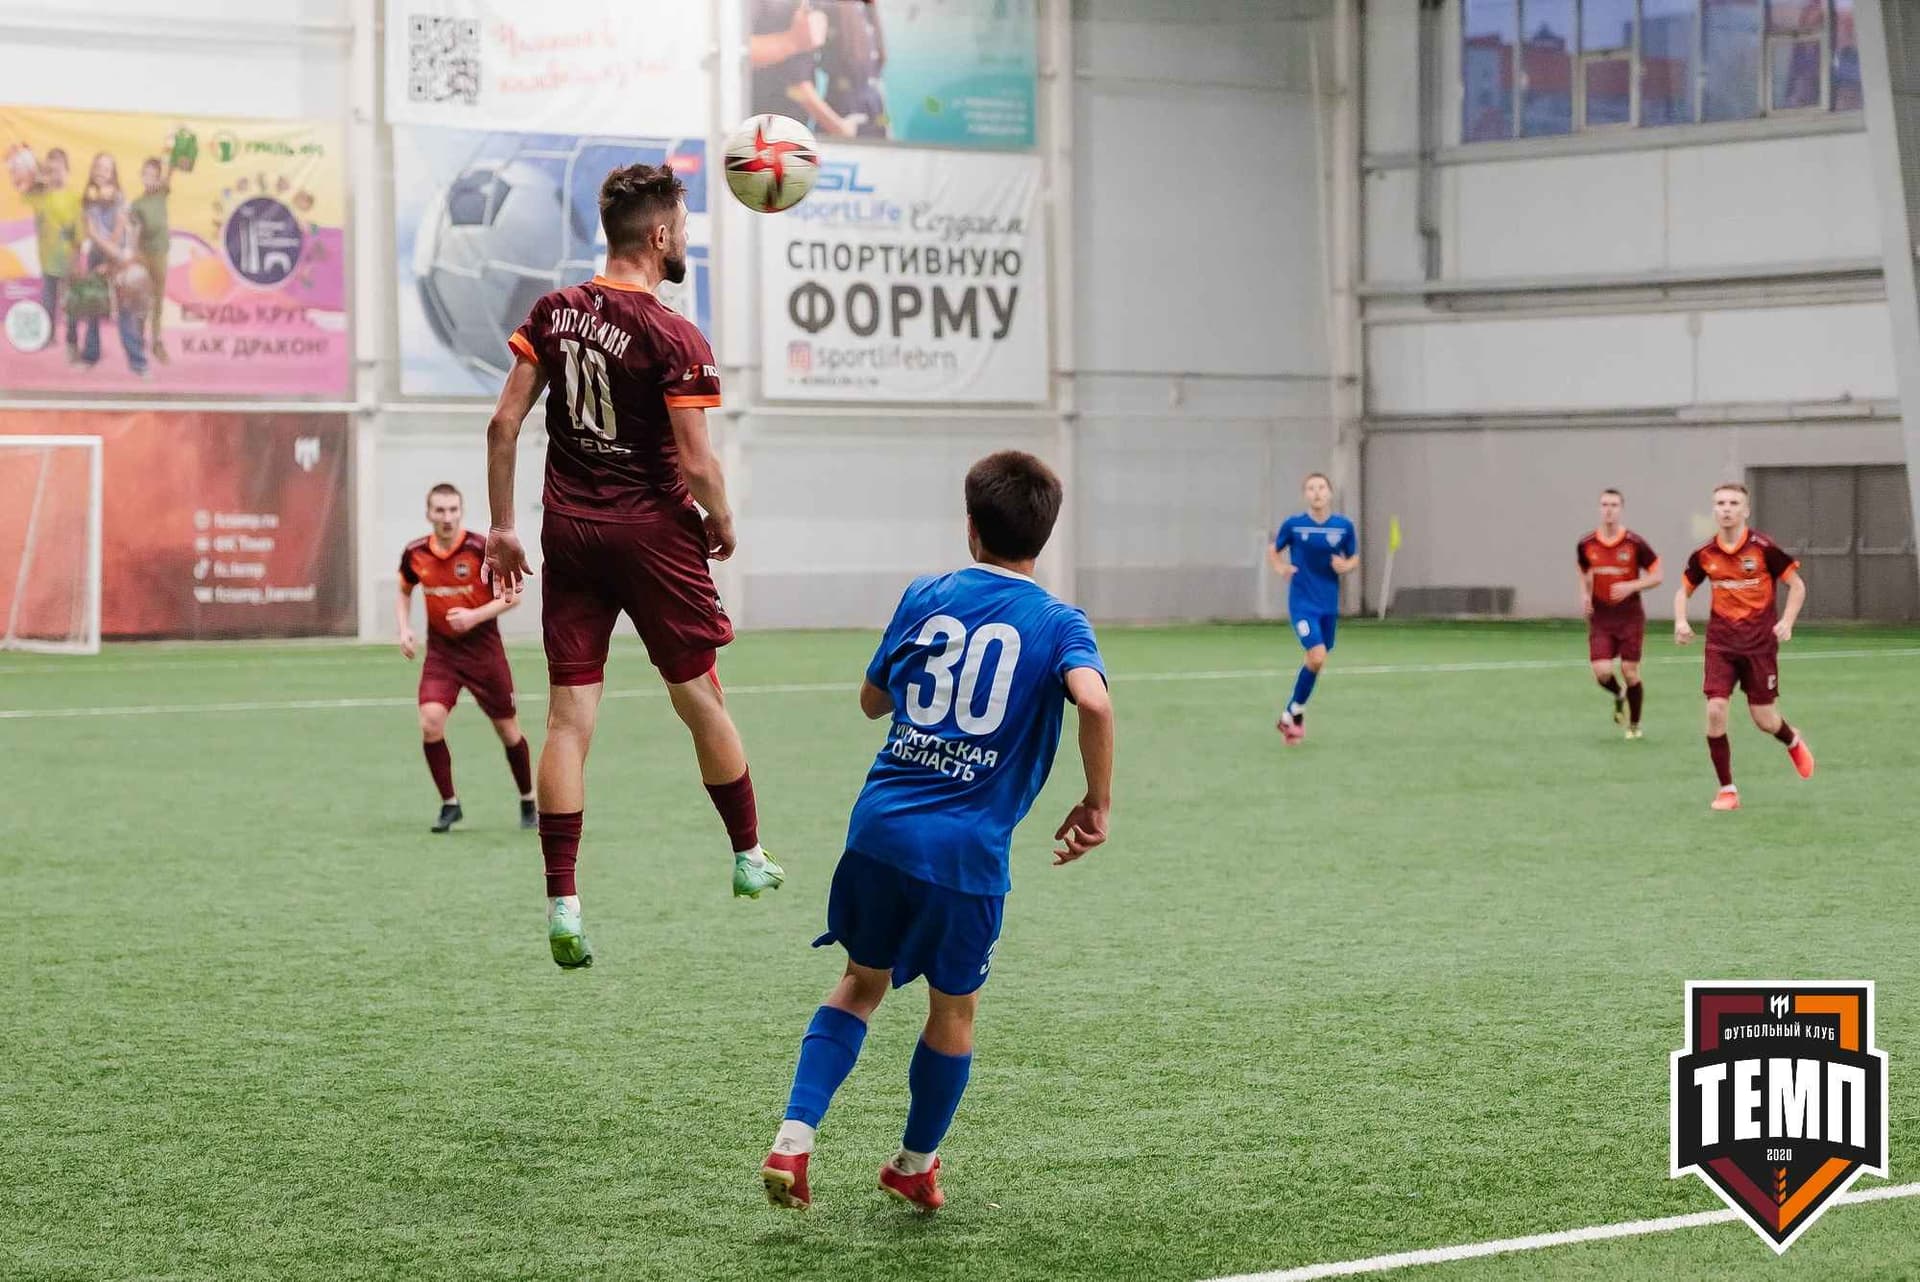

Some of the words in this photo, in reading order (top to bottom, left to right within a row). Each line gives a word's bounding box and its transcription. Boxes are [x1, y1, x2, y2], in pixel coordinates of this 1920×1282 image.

[787, 241, 1021, 277] СПОРТИВНУЮ
[788, 280, 1019, 341] ФОРМУ
[560, 338, 617, 440] 10
[906, 615, 1021, 735] 30
[891, 739, 976, 782] ОБЛАСТЬ
